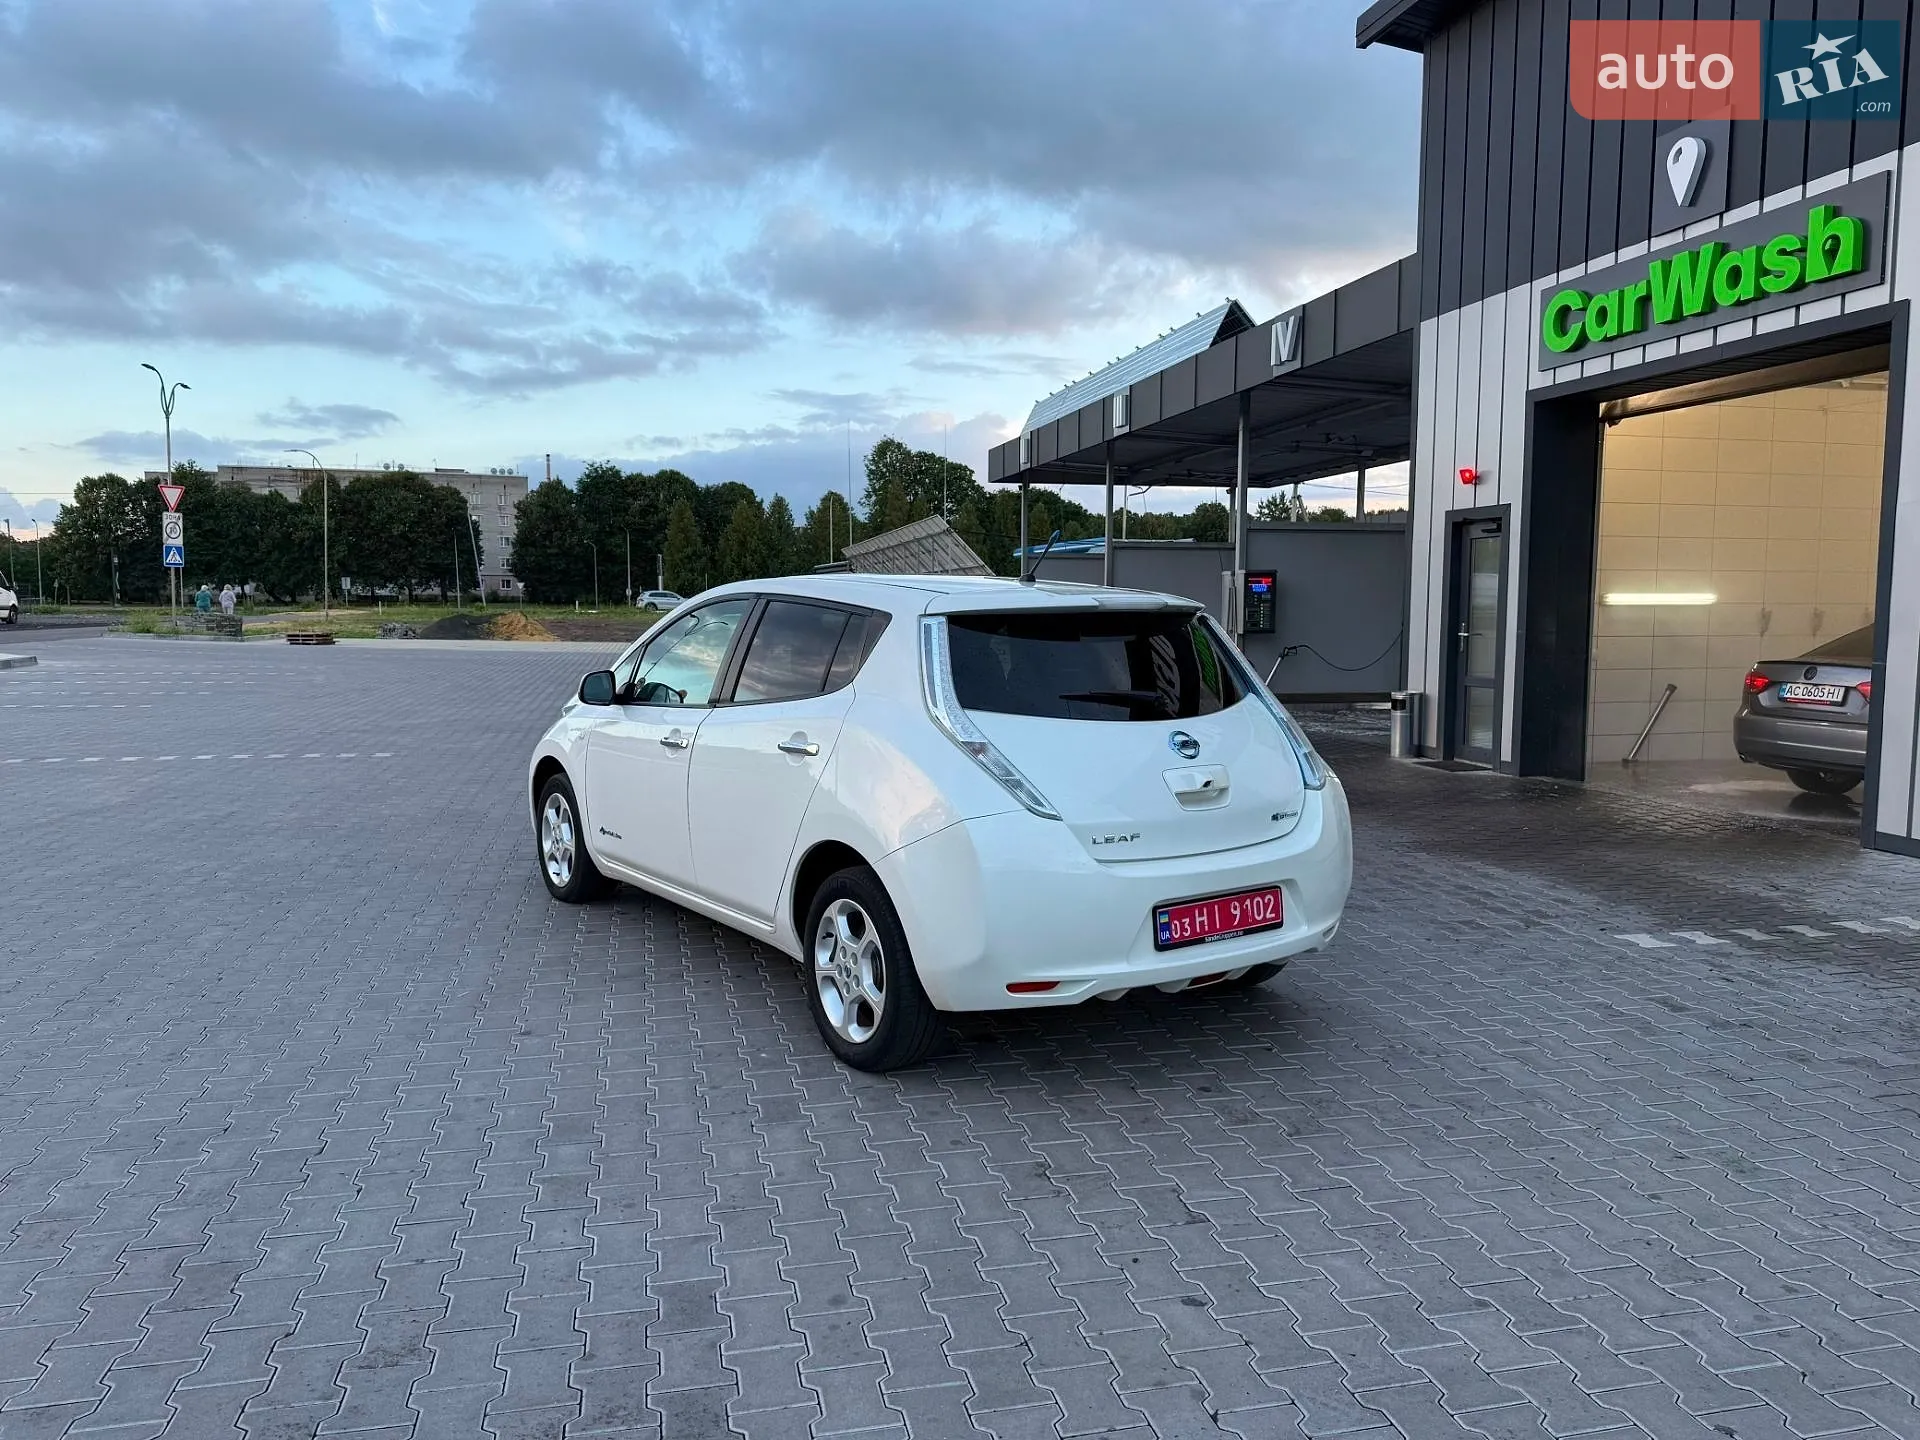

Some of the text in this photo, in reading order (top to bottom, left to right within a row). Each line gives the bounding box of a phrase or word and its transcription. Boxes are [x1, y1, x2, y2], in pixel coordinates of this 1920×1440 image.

[1543, 204, 1864, 353] CarWash
[1270, 315, 1298, 366] IV
[1786, 686, 1801, 696] AC
[1802, 686, 1825, 698] 0605
[1091, 832, 1141, 845] LEAF
[1160, 894, 1276, 941] UA 03 HI 9102
